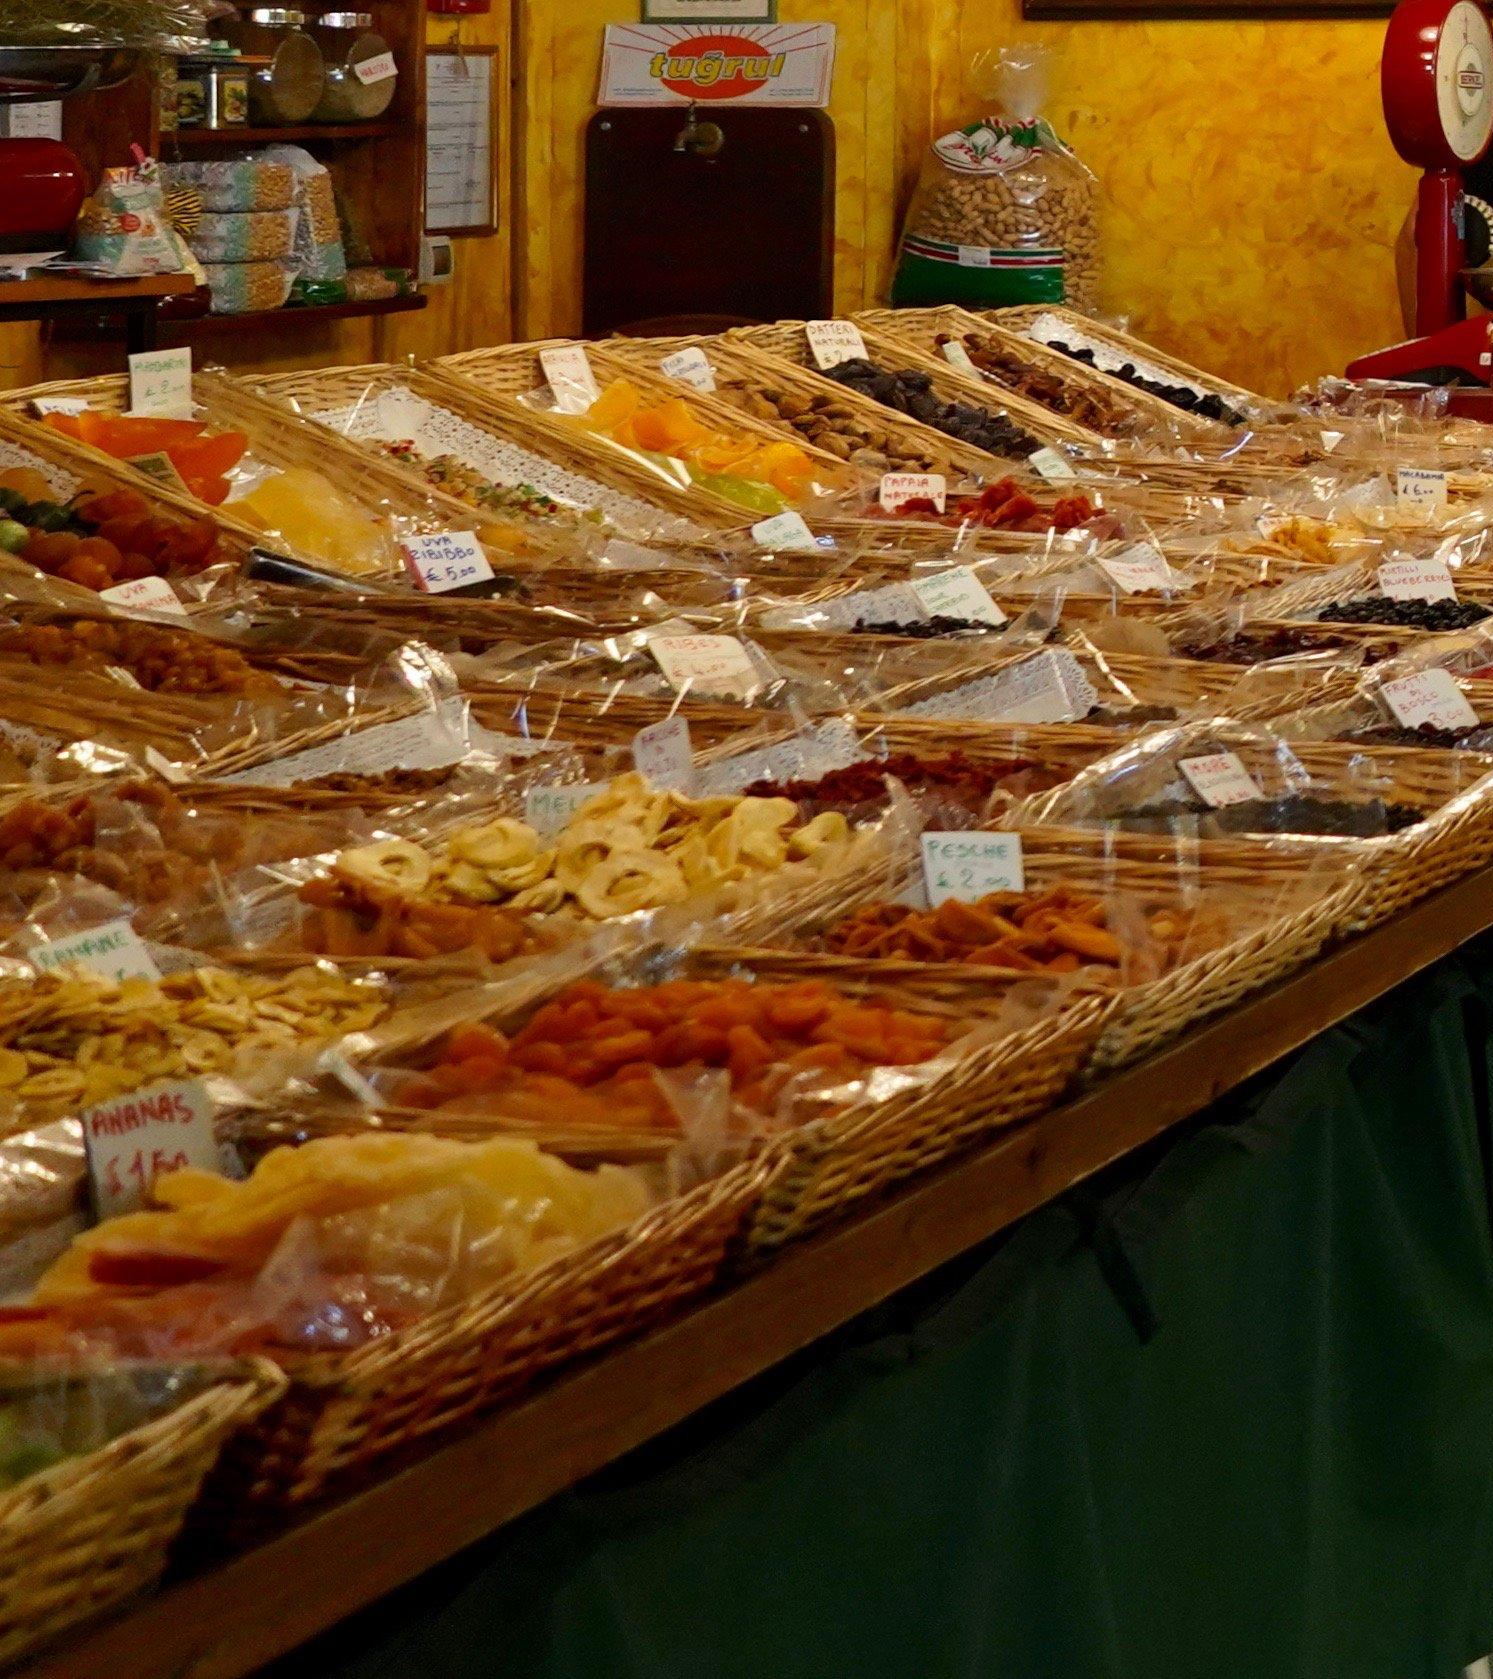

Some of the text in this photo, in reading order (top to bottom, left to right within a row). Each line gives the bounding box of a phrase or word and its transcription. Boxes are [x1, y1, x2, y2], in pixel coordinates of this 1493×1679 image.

[650, 51, 786, 87] tuğrul
[421, 536, 452, 547] UVA
[410, 547, 475, 560] ZIBIBBO
[927, 839, 1009, 859] PESCHE
[92, 1091, 195, 1137] ANANAS
